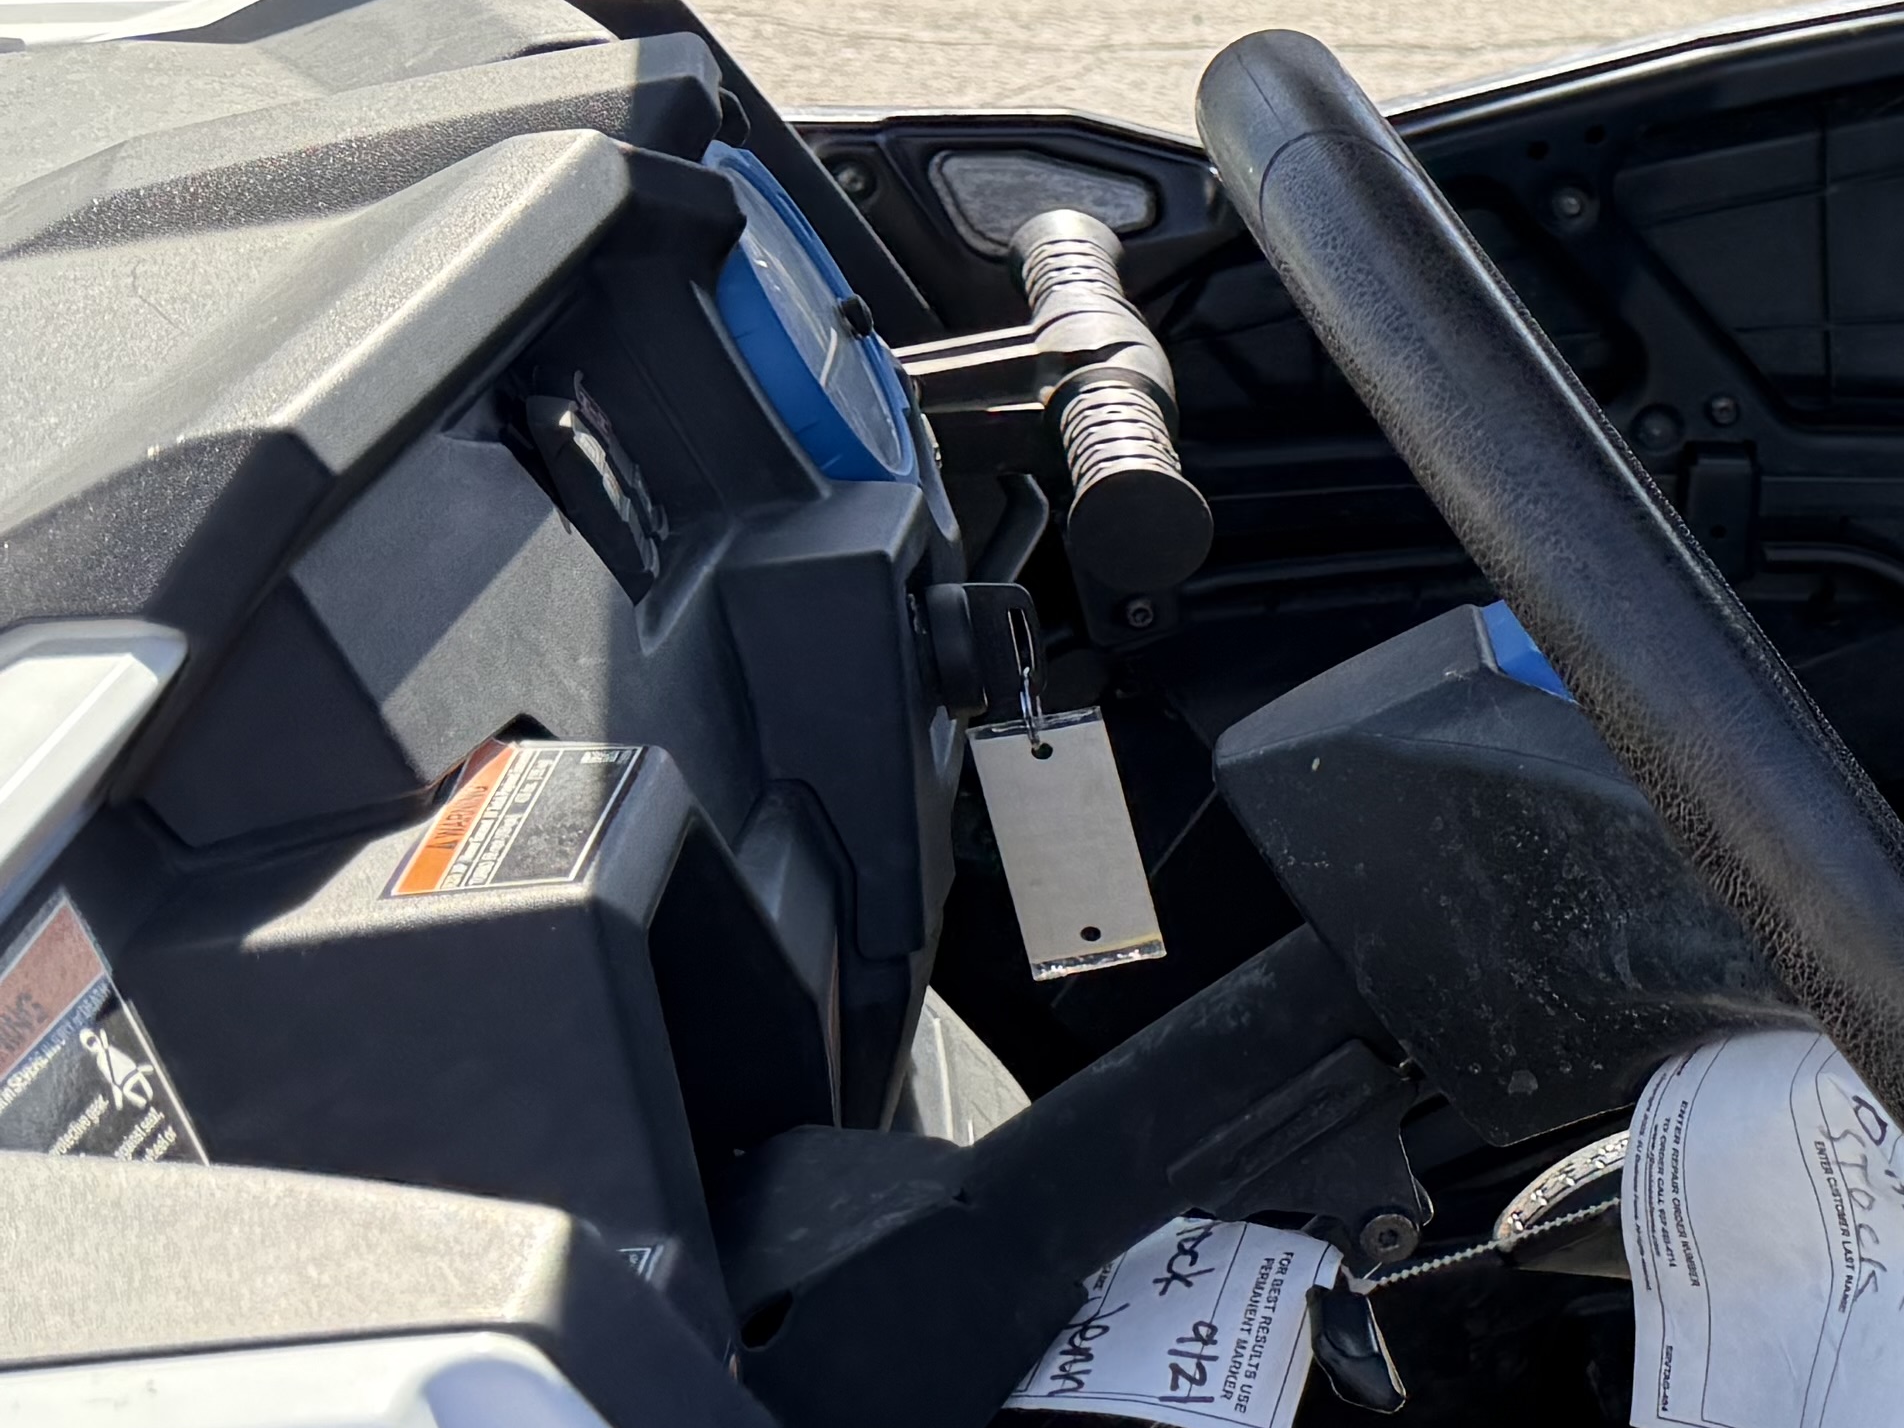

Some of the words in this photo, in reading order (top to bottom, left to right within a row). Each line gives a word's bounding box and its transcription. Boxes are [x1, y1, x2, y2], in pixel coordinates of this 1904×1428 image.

[1661, 1116, 1671, 1136] TO
[1672, 1099, 1689, 1145] ENTER
[1656, 1133, 1667, 1176] ORDER
[1670, 1145, 1680, 1196] REPAIR
[1813, 1139, 1835, 1178] ENTER
[1656, 1176, 1665, 1207] CALL
[1818, 1123, 1888, 1303] STOCK
[1826, 1172, 1850, 1238] CUSTOMER
[1671, 1197, 1688, 1240] ORDER
[1275, 1251, 1295, 1277] FOR
[1680, 1237, 1701, 1288] NUMBER
[1841, 1238, 1856, 1274] LAST
[1240, 1256, 1276, 1335] PERMANENT
[1264, 1279, 1282, 1313] BEST
[1837, 1274, 1854, 1314] NAME
[1158, 1320, 1220, 1404] 9/21
[1219, 1334, 1248, 1401] MARKER
[1248, 1314, 1273, 1382] RESULTS
[1234, 1382, 1253, 1415] USE
